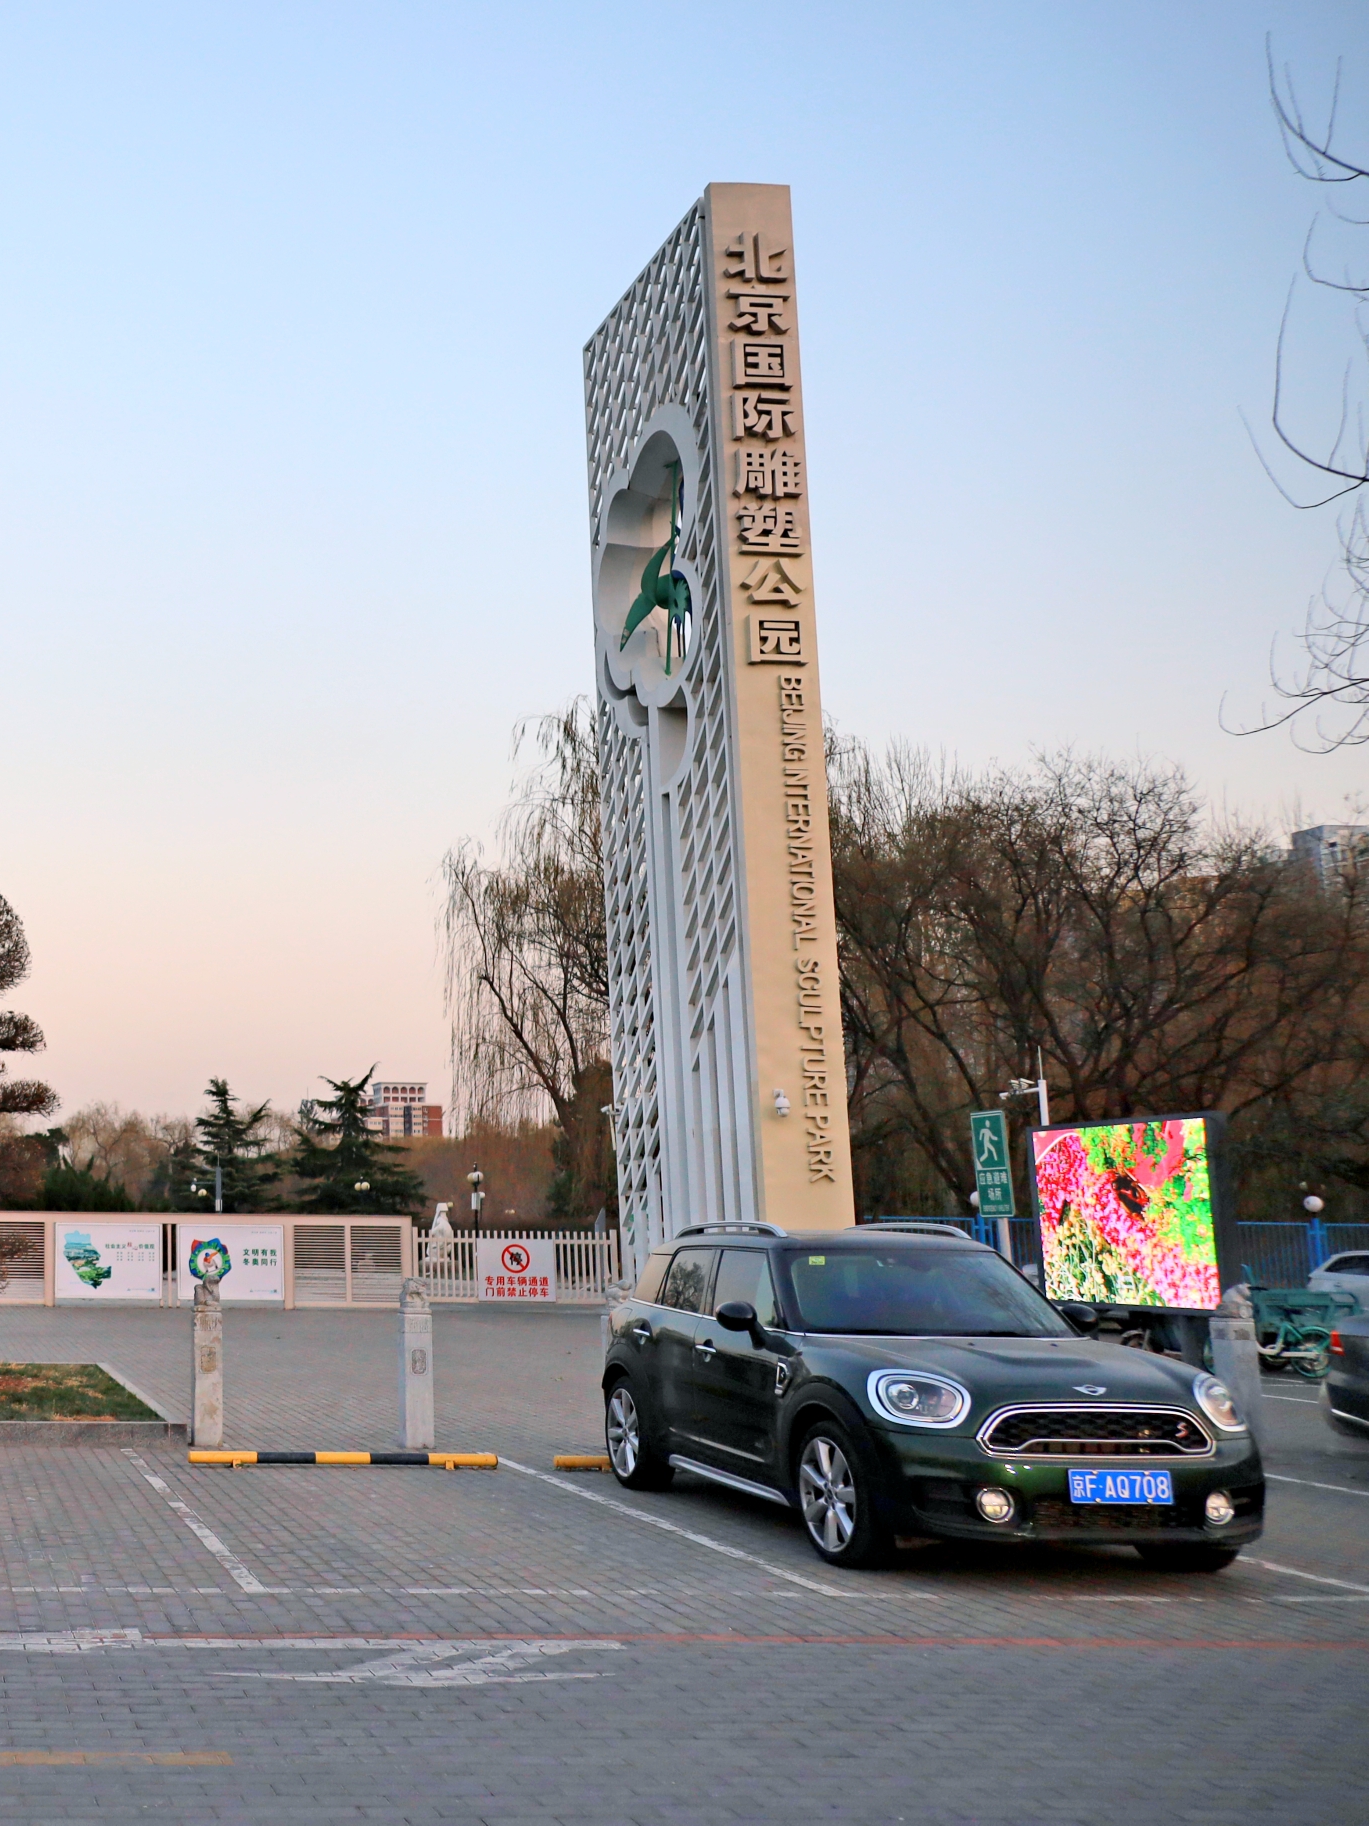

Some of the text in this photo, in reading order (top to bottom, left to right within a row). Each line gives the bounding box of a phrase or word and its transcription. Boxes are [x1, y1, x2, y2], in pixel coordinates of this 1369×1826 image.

[724, 231, 809, 665] 北京国际雕塑公园
[778, 675, 836, 1184] BEIJING INTERNATIONAL SCULPTURE PARK
[243, 1258, 277, 1266] 冬奥同行
[485, 1276, 549, 1287] 专用车辆通道
[485, 1287, 549, 1298] 门前禁止停车
